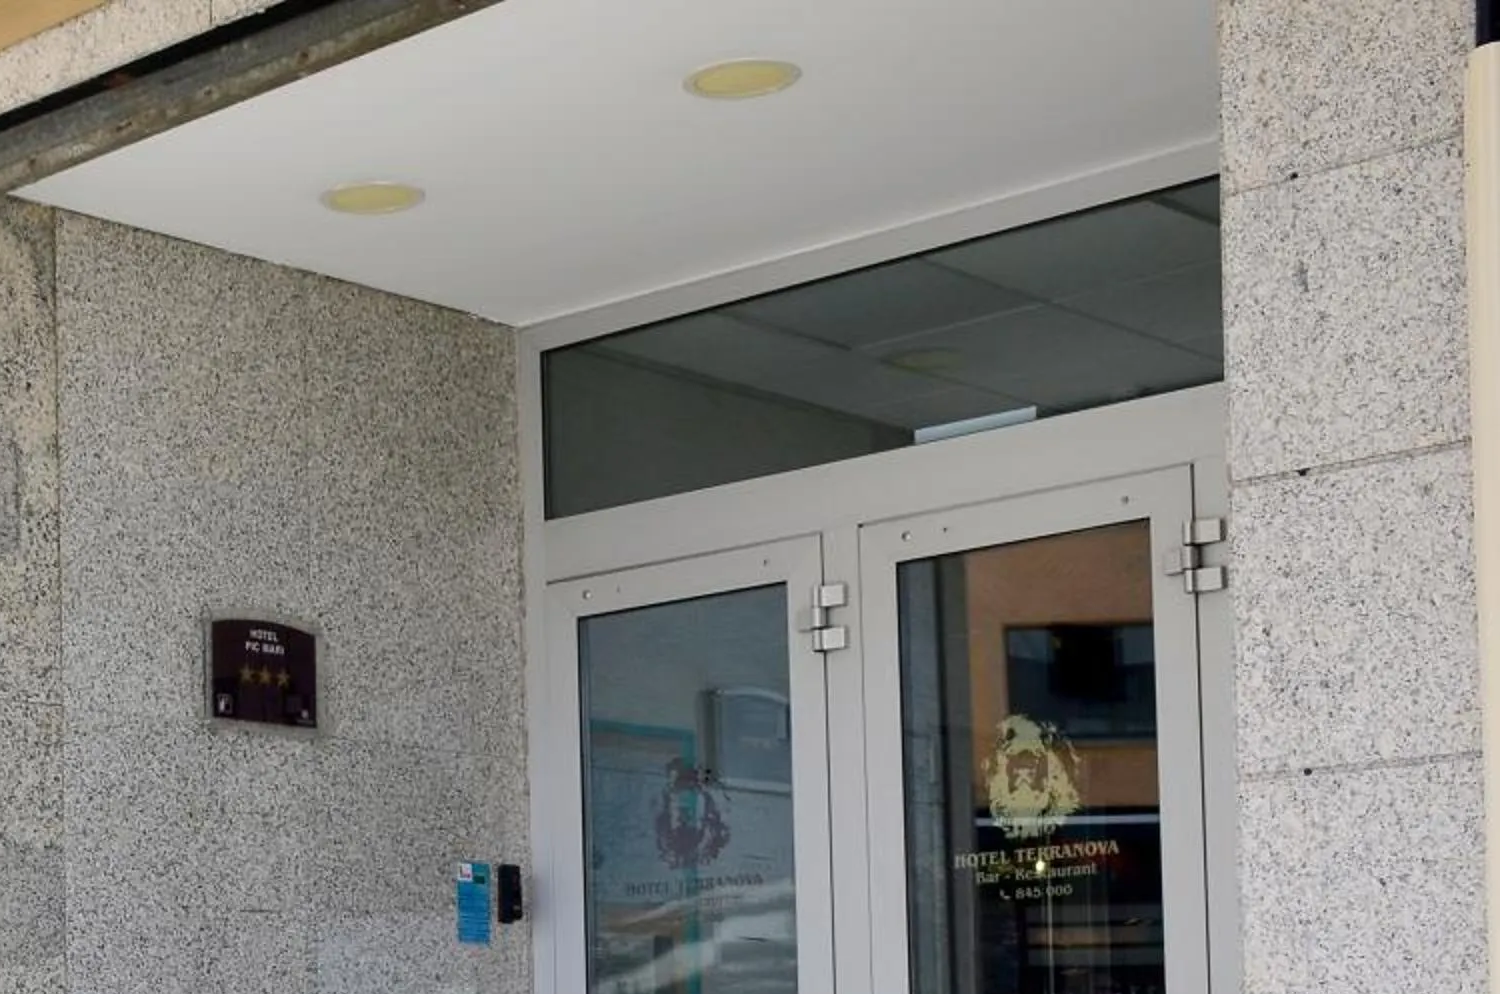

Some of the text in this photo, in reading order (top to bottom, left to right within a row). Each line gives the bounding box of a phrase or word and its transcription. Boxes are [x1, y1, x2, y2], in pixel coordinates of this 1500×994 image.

[249, 629, 278, 642] HOTEL
[954, 840, 1119, 868] HOTEL TERRANOVA
[976, 870, 1000, 884] Bar
[1015, 883, 1073, 899] 845 000
